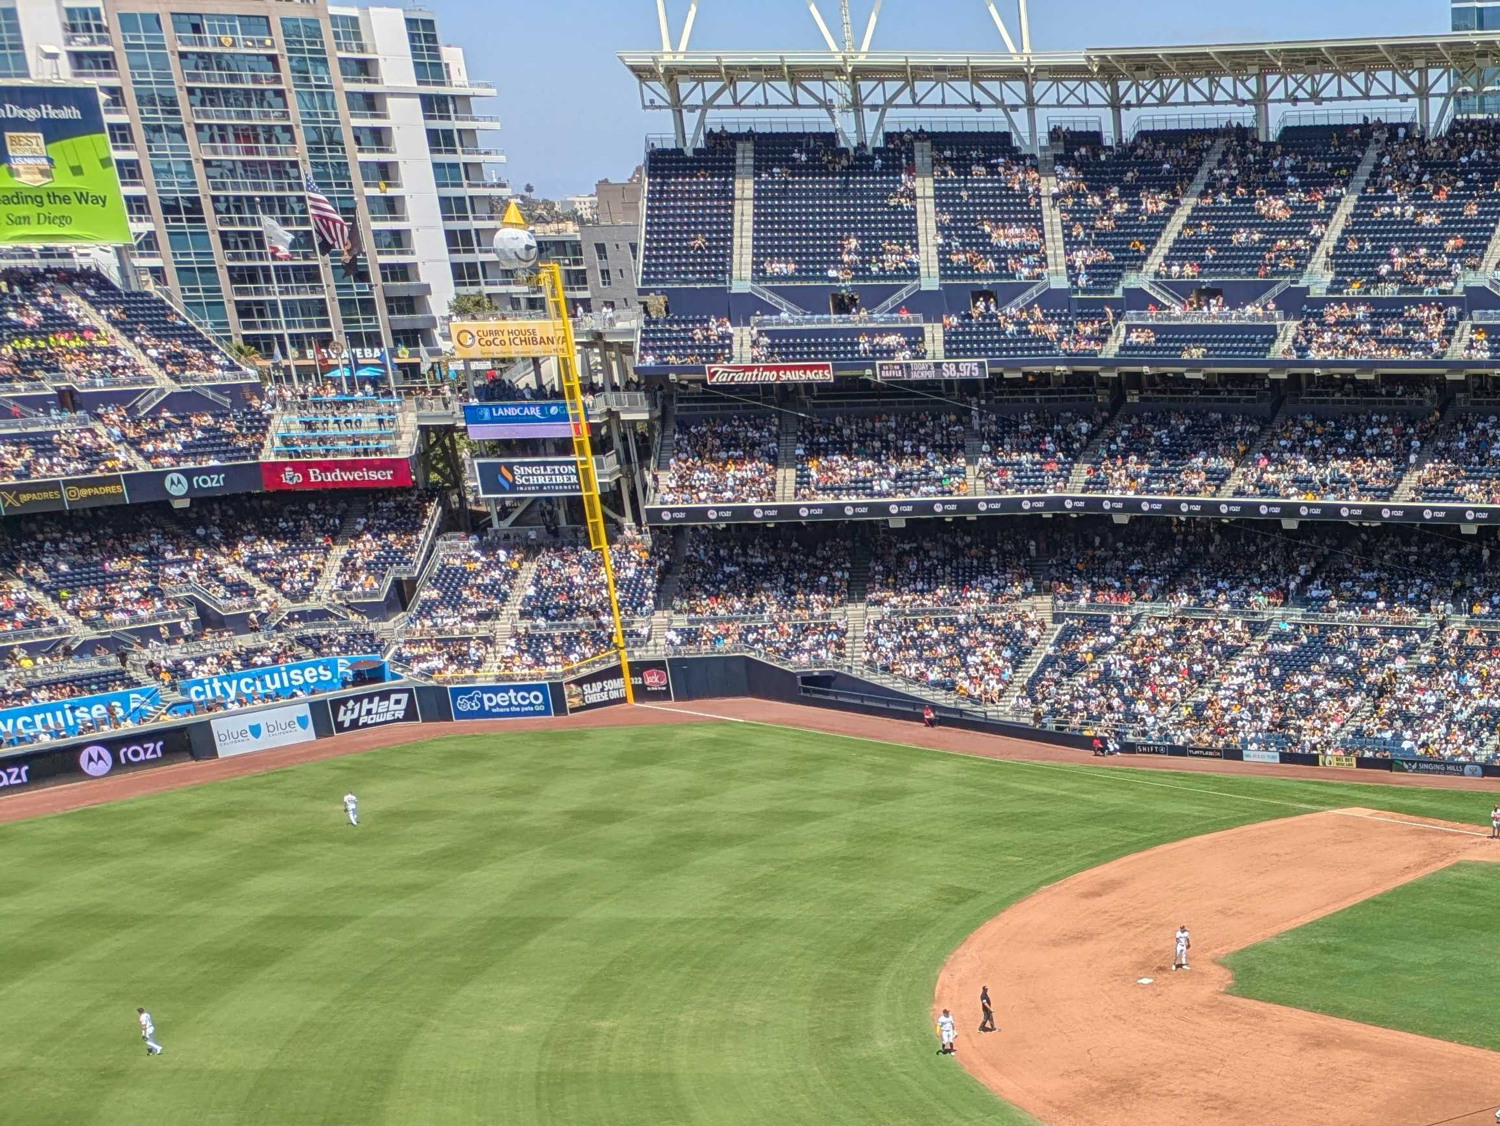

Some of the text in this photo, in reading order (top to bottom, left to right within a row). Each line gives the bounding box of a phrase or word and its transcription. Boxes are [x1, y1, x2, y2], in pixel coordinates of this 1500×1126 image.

[4, 103, 41, 121] Diego
[40, 104, 82, 120] Health
[9, 135, 41, 147] BEST
[49, 192, 72, 205] the
[73, 191, 107, 207] Way
[6, 212, 73, 227] San Diego
[476, 328, 537, 337] CURRY HOUSE
[478, 335, 567, 347] CoCo ICHIBANYA
[709, 367, 831, 383] Tarantino SAUSAGES
[911, 370, 935, 378] JACKPOT
[942, 363, 979, 378] $8,975
[492, 406, 542, 417] LANDCARE
[308, 468, 394, 482] Budweiser
[513, 465, 576, 475] SINGLETON
[193, 473, 225, 489] razr
[515, 474, 578, 485] SCHREIBER
[19, 491, 61, 503] @PADRES
[80, 485, 123, 497] @PADRES
[190, 664, 332, 703] citycruises
[583, 678, 625, 694] SLAP SOME
[361, 693, 408, 716] H2O
[483, 689, 544, 709] petco
[584, 692, 608, 704] CHEESE
[609, 690, 619, 700] ON
[359, 710, 405, 726] POWER
[216, 718, 296, 744] blue blue
[120, 740, 164, 765] razr
[1418, 762, 1463, 773] SINGING HILLS
